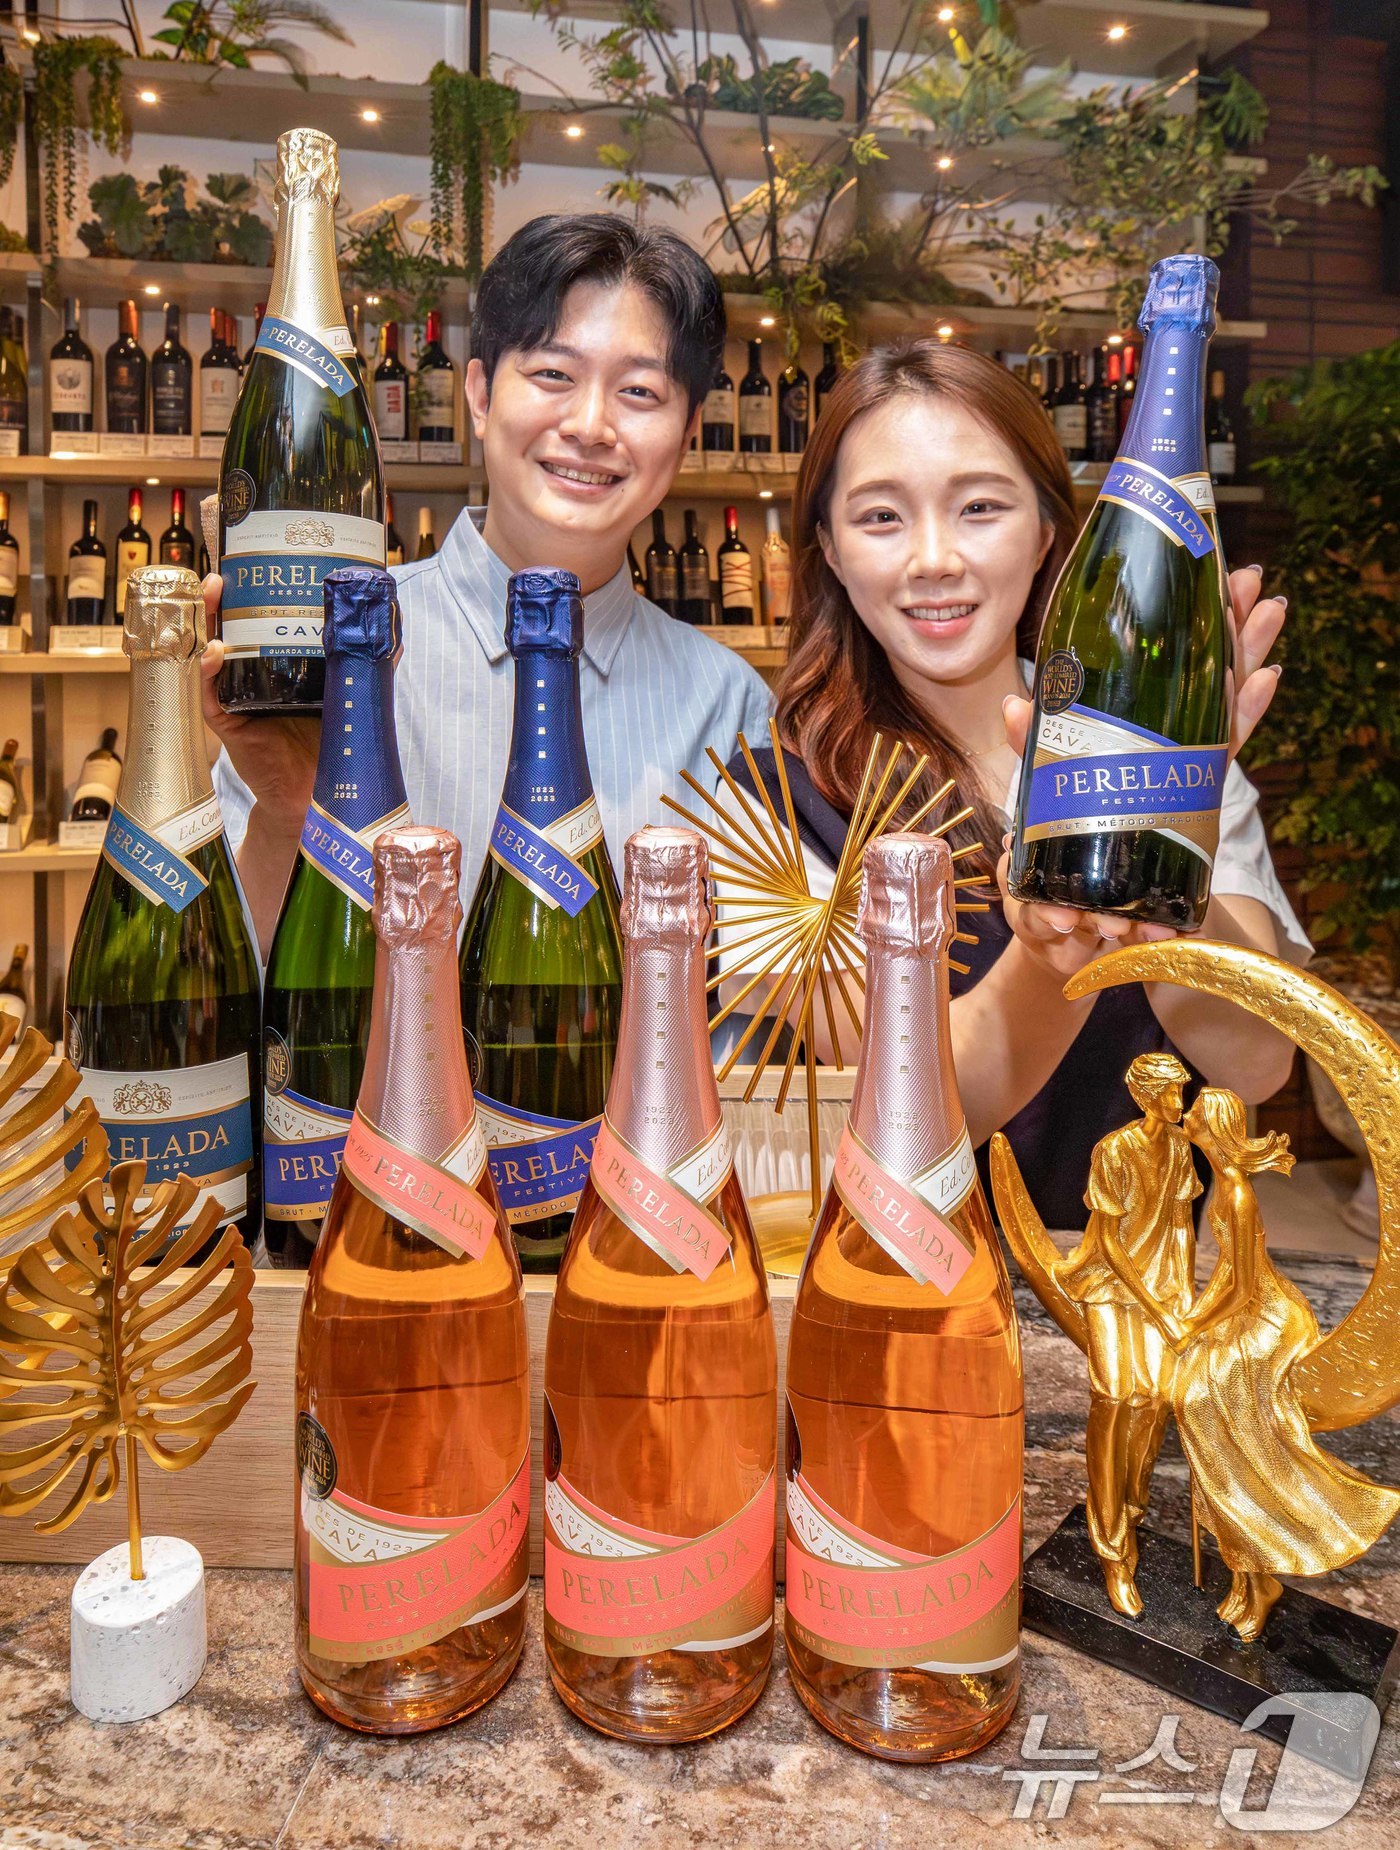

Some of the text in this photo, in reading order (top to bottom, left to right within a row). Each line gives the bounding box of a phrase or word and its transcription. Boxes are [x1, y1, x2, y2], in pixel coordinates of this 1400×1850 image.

[268, 327, 344, 387] PERELADA
[1119, 474, 1204, 547] PERELADA
[237, 565, 338, 589] PEREL
[269, 648, 303, 656] GUARDA
[275, 625, 324, 637] CAV
[1043, 678, 1076, 693] WINE
[1042, 728, 1092, 751] CAVA
[1045, 719, 1064, 730] DES
[1054, 763, 1216, 798] PERELADA
[1101, 795, 1186, 806] FESTIVAL
[1097, 817, 1156, 828] MÉTODO
[107, 821, 190, 898] PERELADA
[311, 826, 375, 890] PERELA
[499, 823, 581, 901] PERELADA
[266, 1105, 305, 1140] CAVA
[156, 1160, 190, 1171] 1923
[514, 1172, 587, 1197] FESTIVA
[940, 1168, 961, 1198] Ed.
[279, 1208, 304, 1216] BRUT
[374, 1155, 484, 1241] PERELADA
[607, 1157, 712, 1261] PERELADA
[846, 1162, 955, 1273] PERELADA
[314, 1514, 379, 1562] CAVA
[348, 1527, 366, 1541] DE
[375, 1537, 414, 1553] 1923
[548, 1494, 593, 1556] CAVA
[568, 1515, 583, 1533] DE
[590, 1533, 624, 1558] 1923
[788, 1494, 833, 1561] CAVA
[809, 1517, 824, 1536] DE
[830, 1539, 864, 1567] 1923
[337, 1499, 522, 1613] PERELADA
[561, 1536, 751, 1608] PERELADA
[800, 1559, 995, 1620] PERELADA
